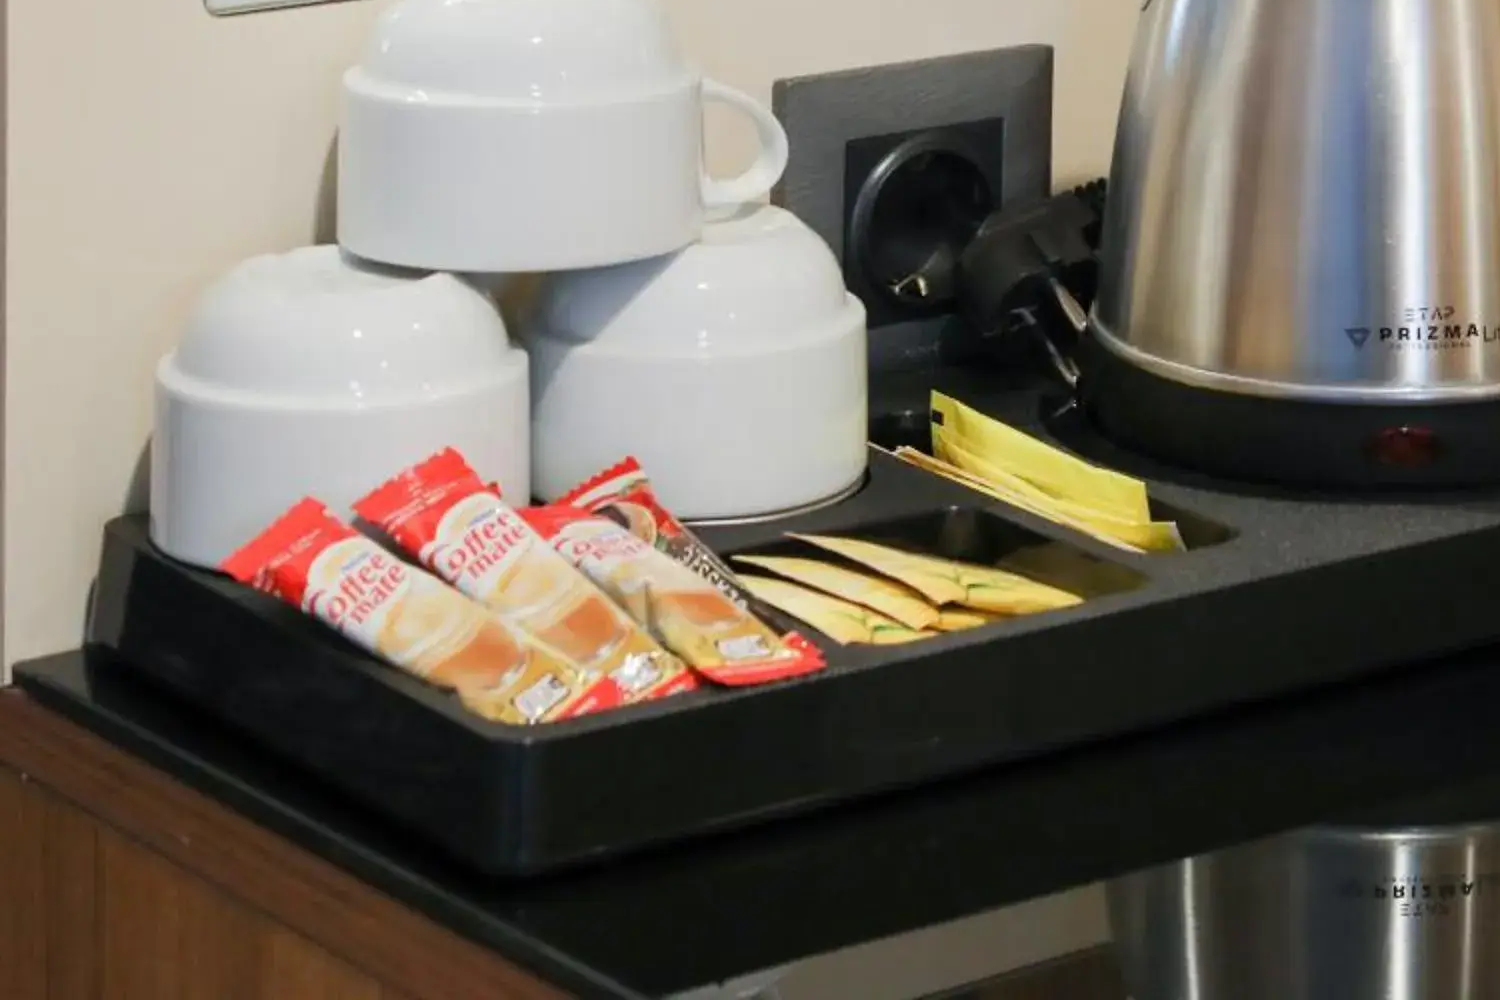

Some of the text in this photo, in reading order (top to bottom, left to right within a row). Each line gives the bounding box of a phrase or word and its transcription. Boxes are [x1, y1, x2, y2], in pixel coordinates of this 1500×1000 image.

[1379, 324, 1479, 342] PRIZMA
[468, 524, 526, 579] mate
[350, 564, 406, 624] mate
